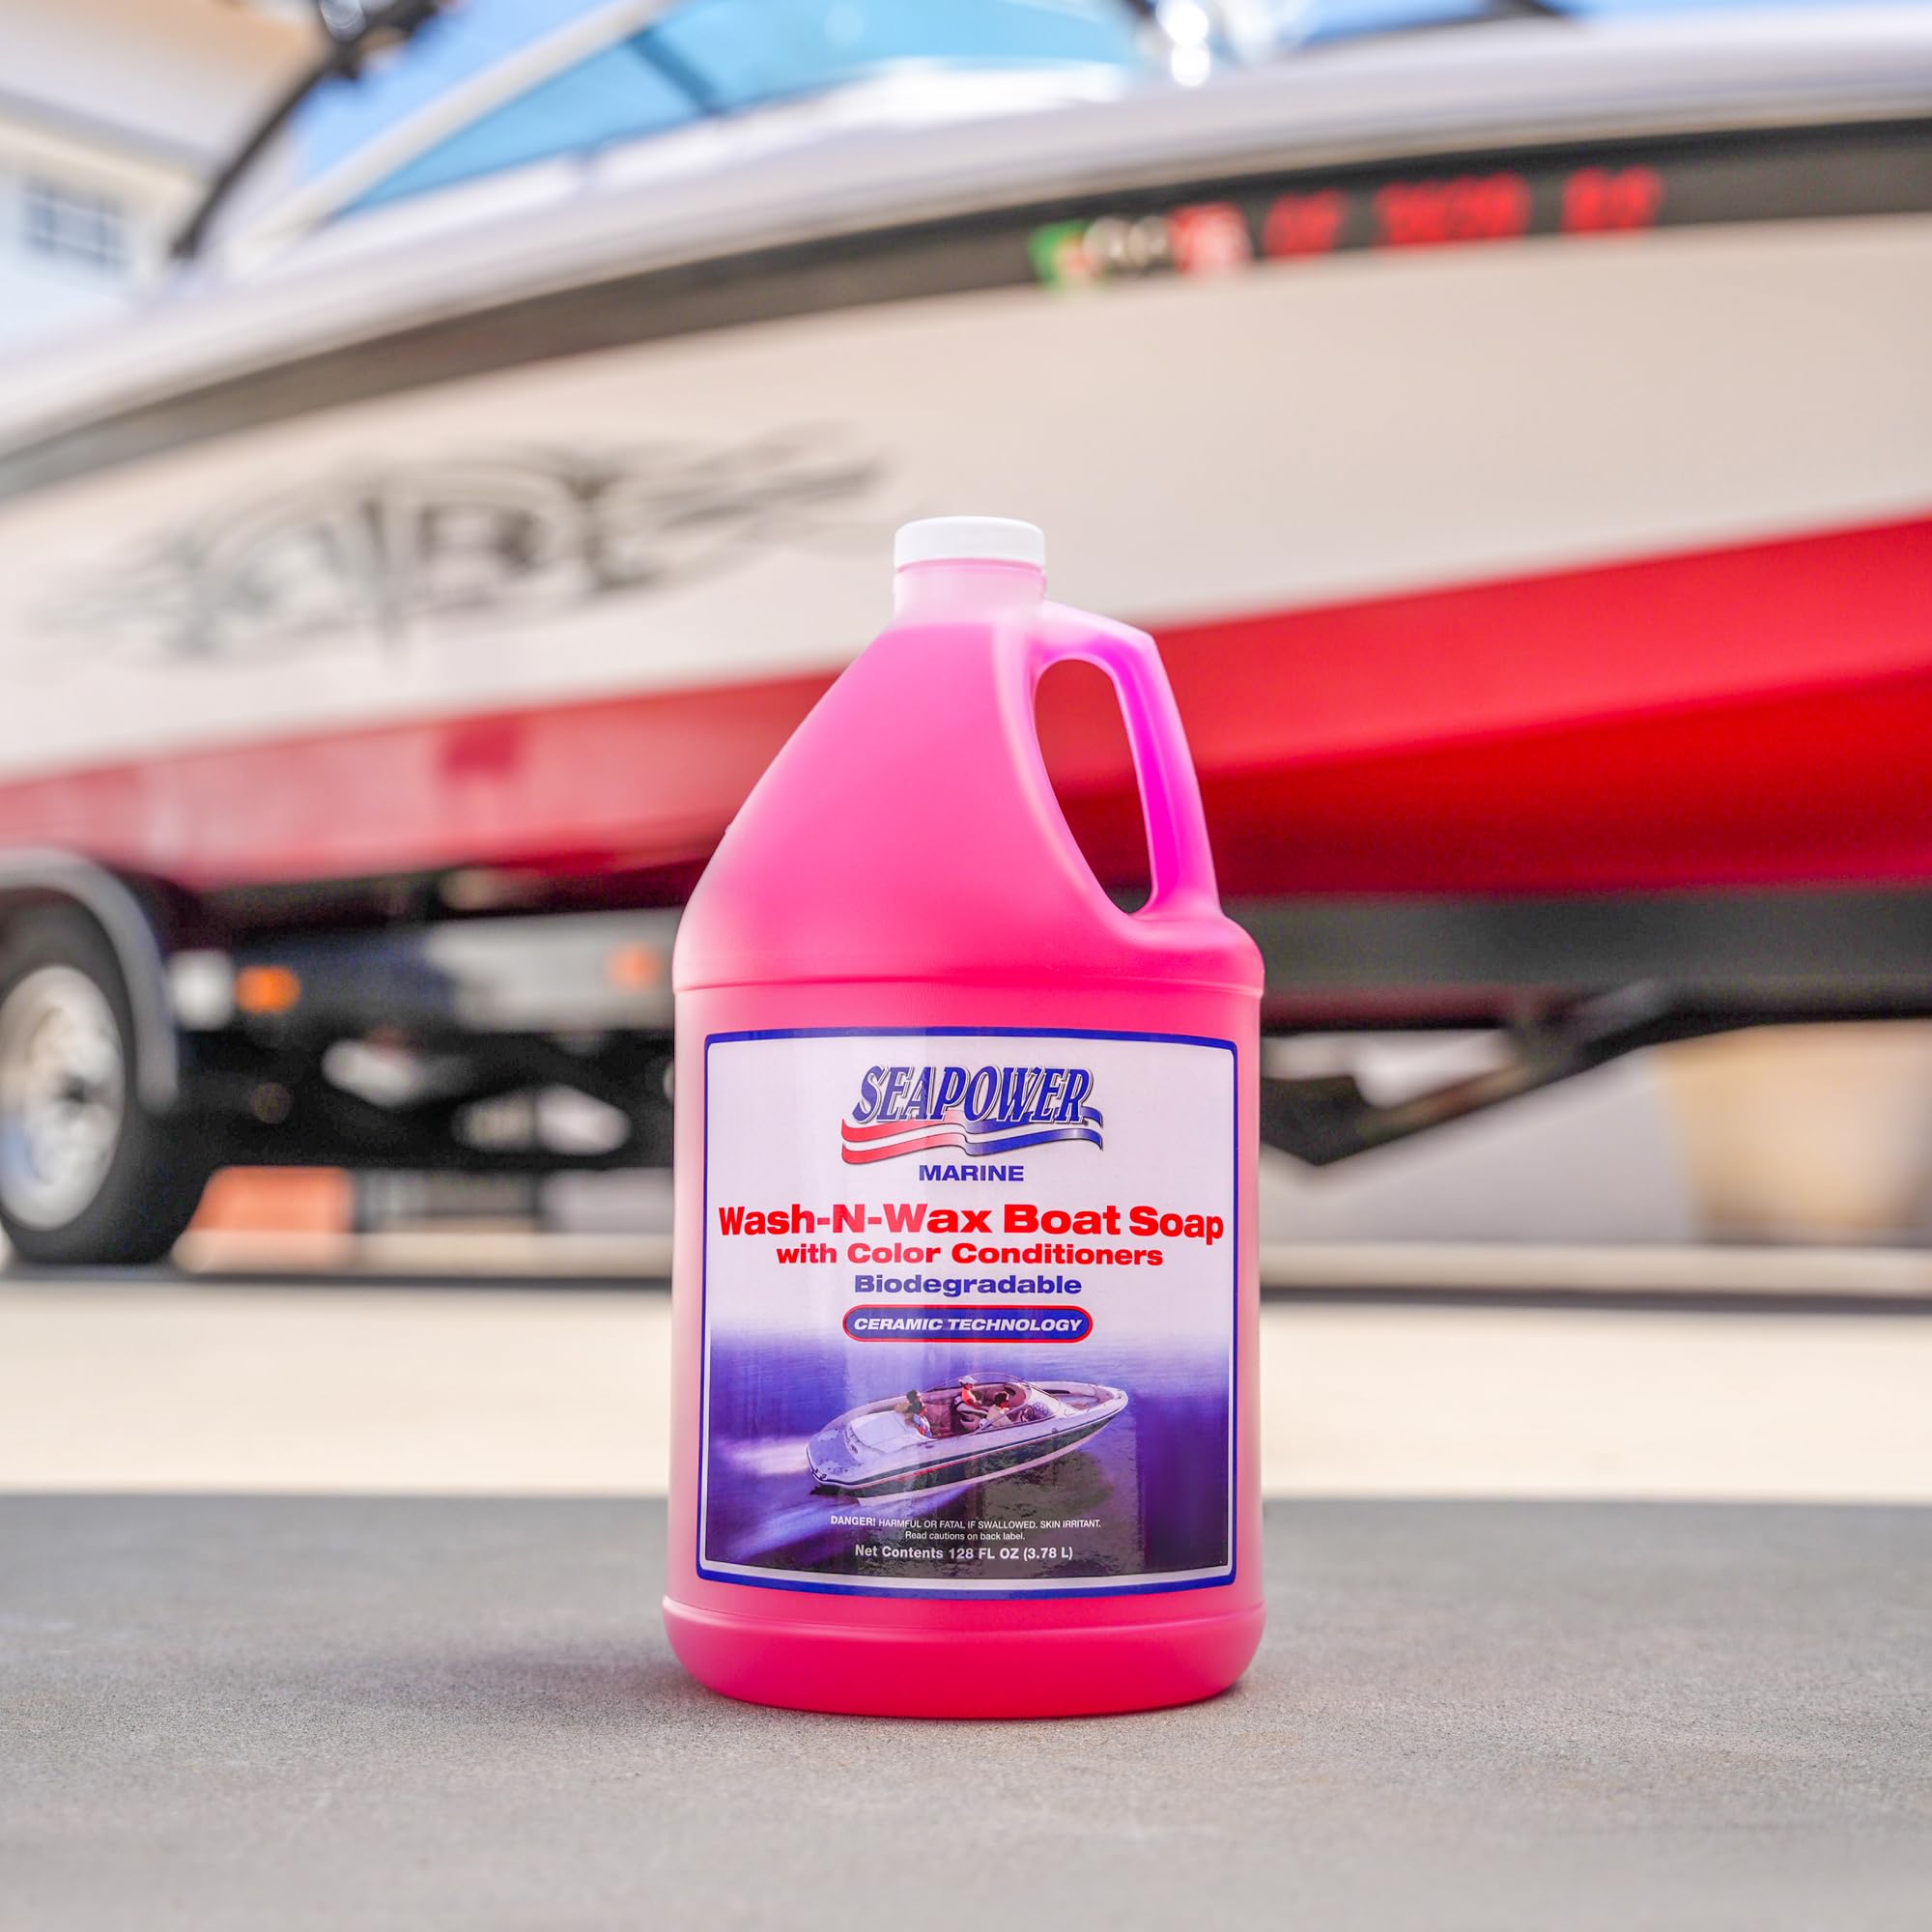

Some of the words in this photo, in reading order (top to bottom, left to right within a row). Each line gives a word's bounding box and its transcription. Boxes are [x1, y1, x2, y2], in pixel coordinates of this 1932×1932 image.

[851, 1065, 1094, 1123] SEAPOWER
[919, 1165, 1024, 1181] MARINE
[719, 1204, 992, 1236] Wash-N-Wax
[1004, 1204, 1121, 1235] Boat
[1129, 1206, 1224, 1245] Soap
[776, 1242, 838, 1264] with
[847, 1242, 941, 1264] Color
[952, 1242, 1163, 1265] Conditioners
[855, 1274, 1082, 1297] Biodegradable
[854, 1318, 944, 1331] CERAMIC
[947, 1319, 1082, 1332] TECHNOLOGY
[830, 1515, 876, 1526] DANGER!
[878, 1518, 922, 1529] HARMFUL
[923, 1520, 938, 1529] OR
[939, 1520, 966, 1529] FATAL
[967, 1520, 976, 1529] IF
[979, 1520, 1038, 1529] SWALLOWED.
[1040, 1520, 1061, 1529] SKIN
[1062, 1520, 1101, 1529] IRRITANT.
[905, 1530, 927, 1540] Read
[928, 1531, 964, 1541] cautions
[980, 1531, 1002, 1541] back
[1003, 1531, 1026, 1541] label.
[855, 1544, 878, 1557] Net
[881, 1547, 944, 1559] Contents
[949, 1548, 974, 1560] 128
[978, 1548, 995, 1560] FL
[999, 1548, 1019, 1560] OZ
[1023, 1547, 1057, 1562] (3.78
[1061, 1547, 1073, 1561] L)
